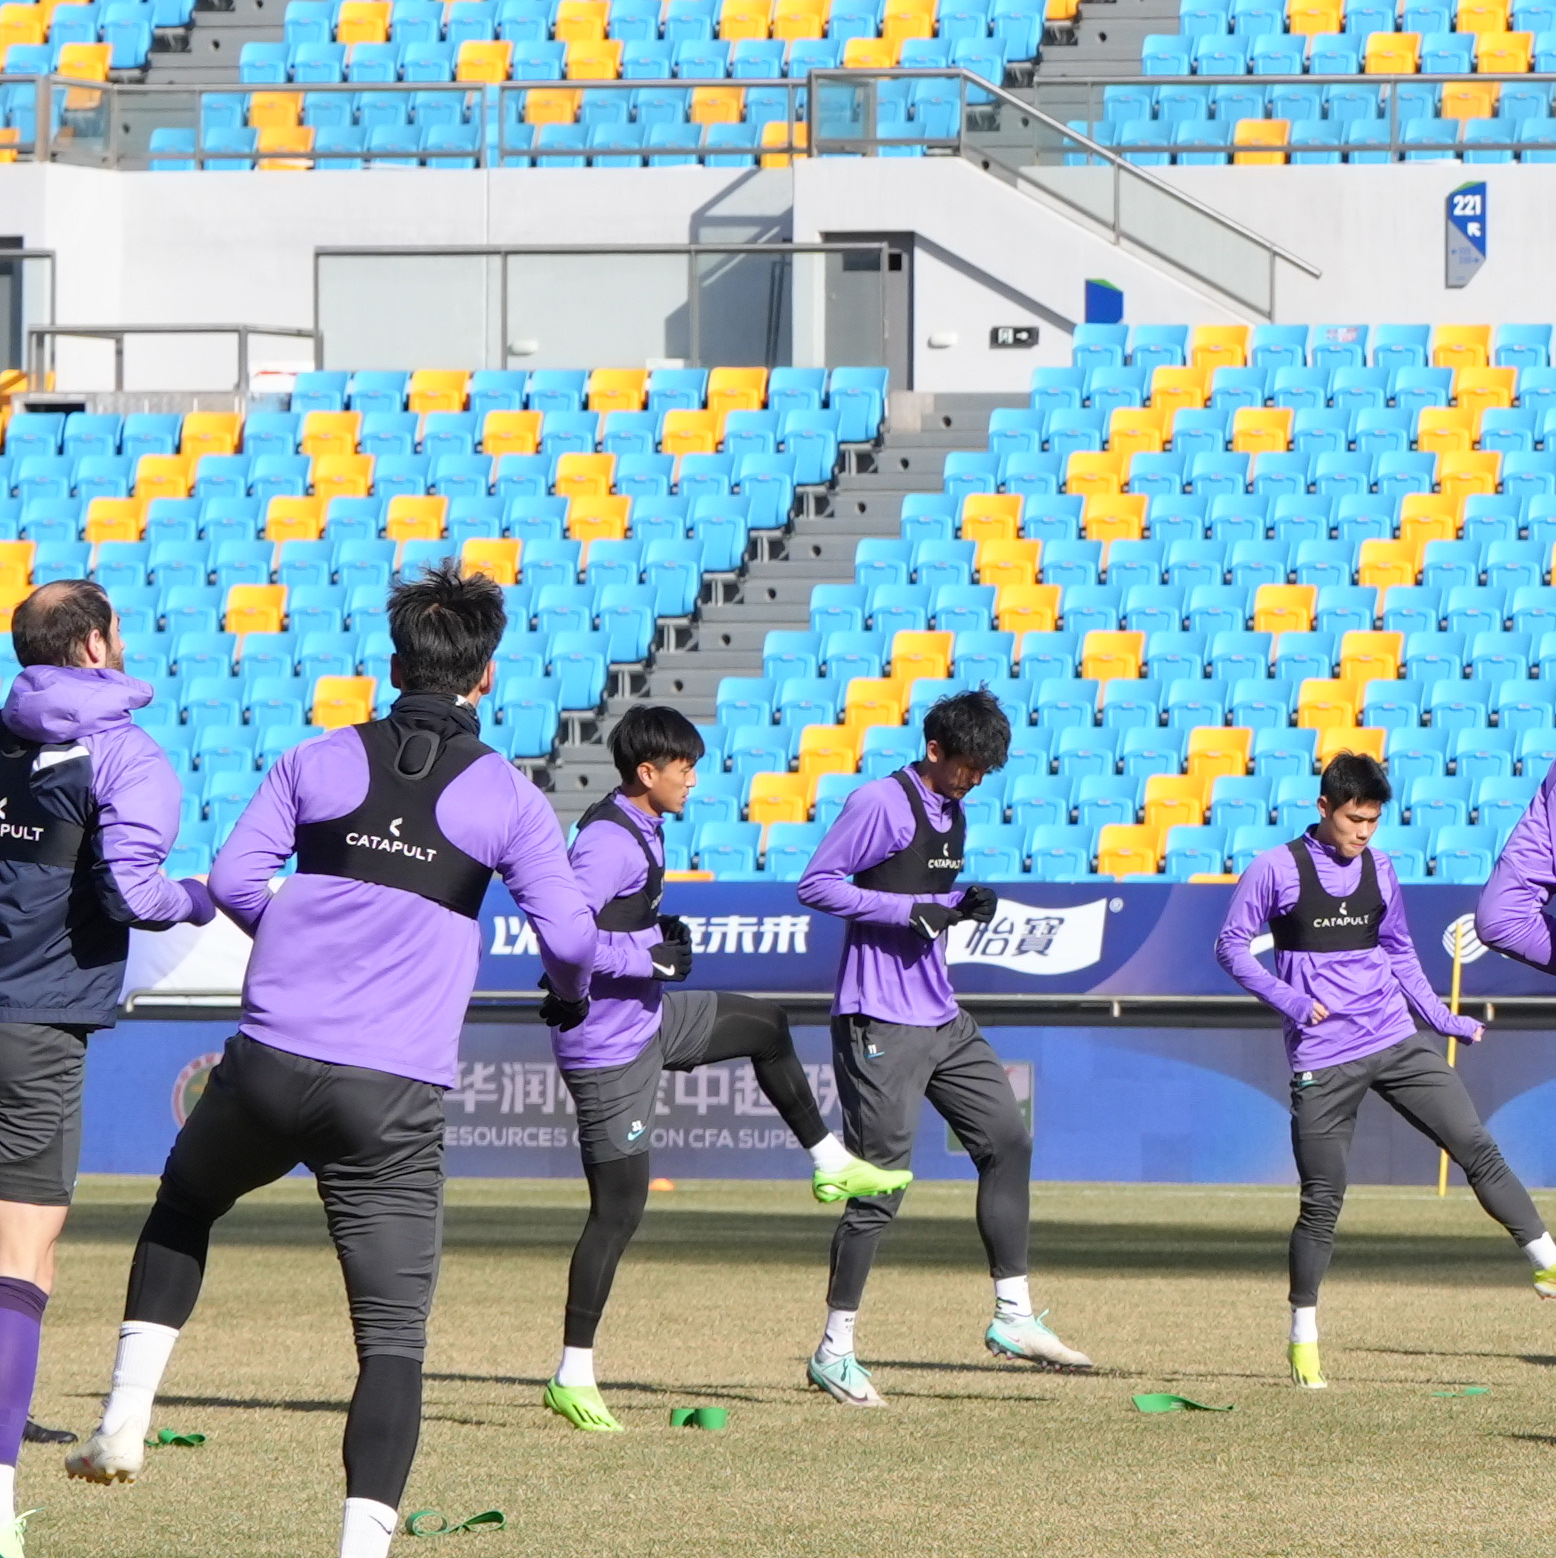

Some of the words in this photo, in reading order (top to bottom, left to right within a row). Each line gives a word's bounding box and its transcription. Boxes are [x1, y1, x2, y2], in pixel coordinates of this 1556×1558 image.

[1452, 193, 1482, 217] 221
[0, 823, 44, 842] PULT
[345, 831, 438, 863] CATAPULT
[1312, 914, 1370, 929] CATAPULT
[443, 1125, 567, 1147] ESOURCES
[688, 1128, 735, 1147] CFA
[738, 1128, 800, 1149] SUPE
